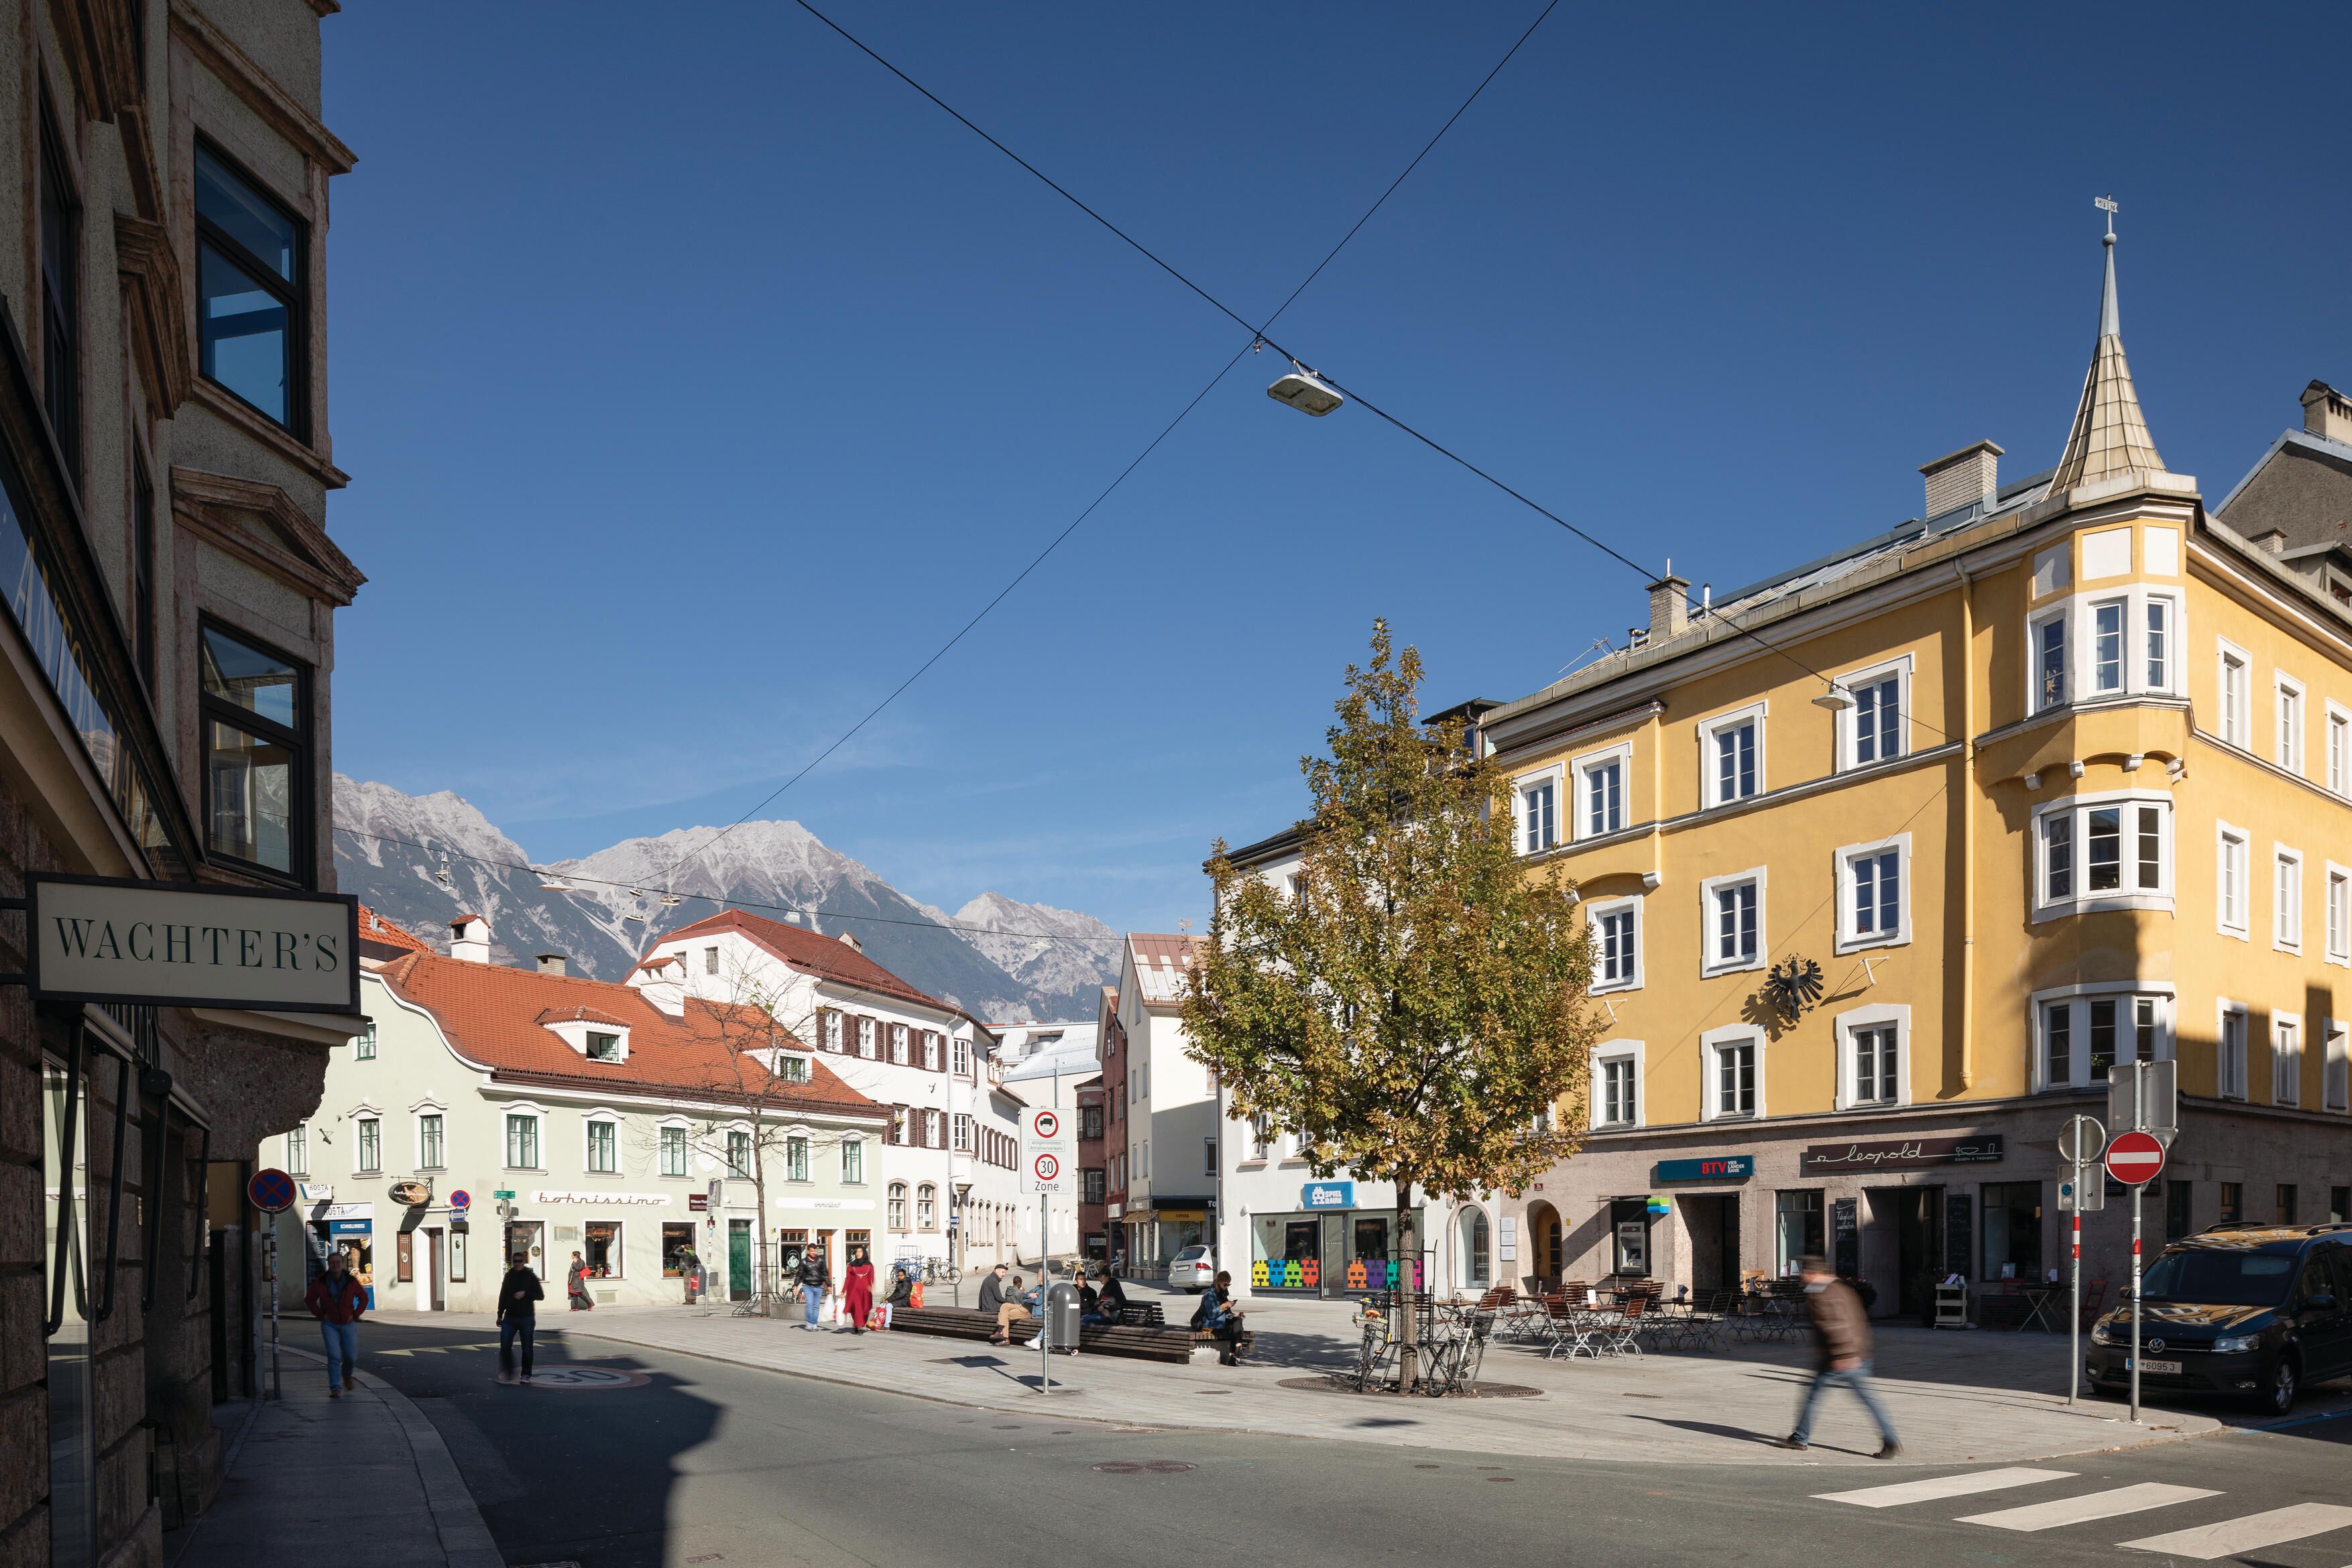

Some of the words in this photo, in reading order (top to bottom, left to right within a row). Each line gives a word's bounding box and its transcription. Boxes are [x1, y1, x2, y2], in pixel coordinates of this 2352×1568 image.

[52, 916, 338, 972] WACHTER'S
[1845, 1142, 1924, 1164] leopold
[1041, 1160, 1053, 1174] 30
[1702, 1160, 1727, 1174] BTV
[1035, 1181, 1059, 1191] Zone
[539, 1192, 666, 1205] bohnissimo
[1325, 1197, 1342, 1205] RAUM
[324, 1207, 345, 1216] HOSTA
[2146, 1362, 2168, 1370] 6095
[2170, 1363, 2175, 1371] J
